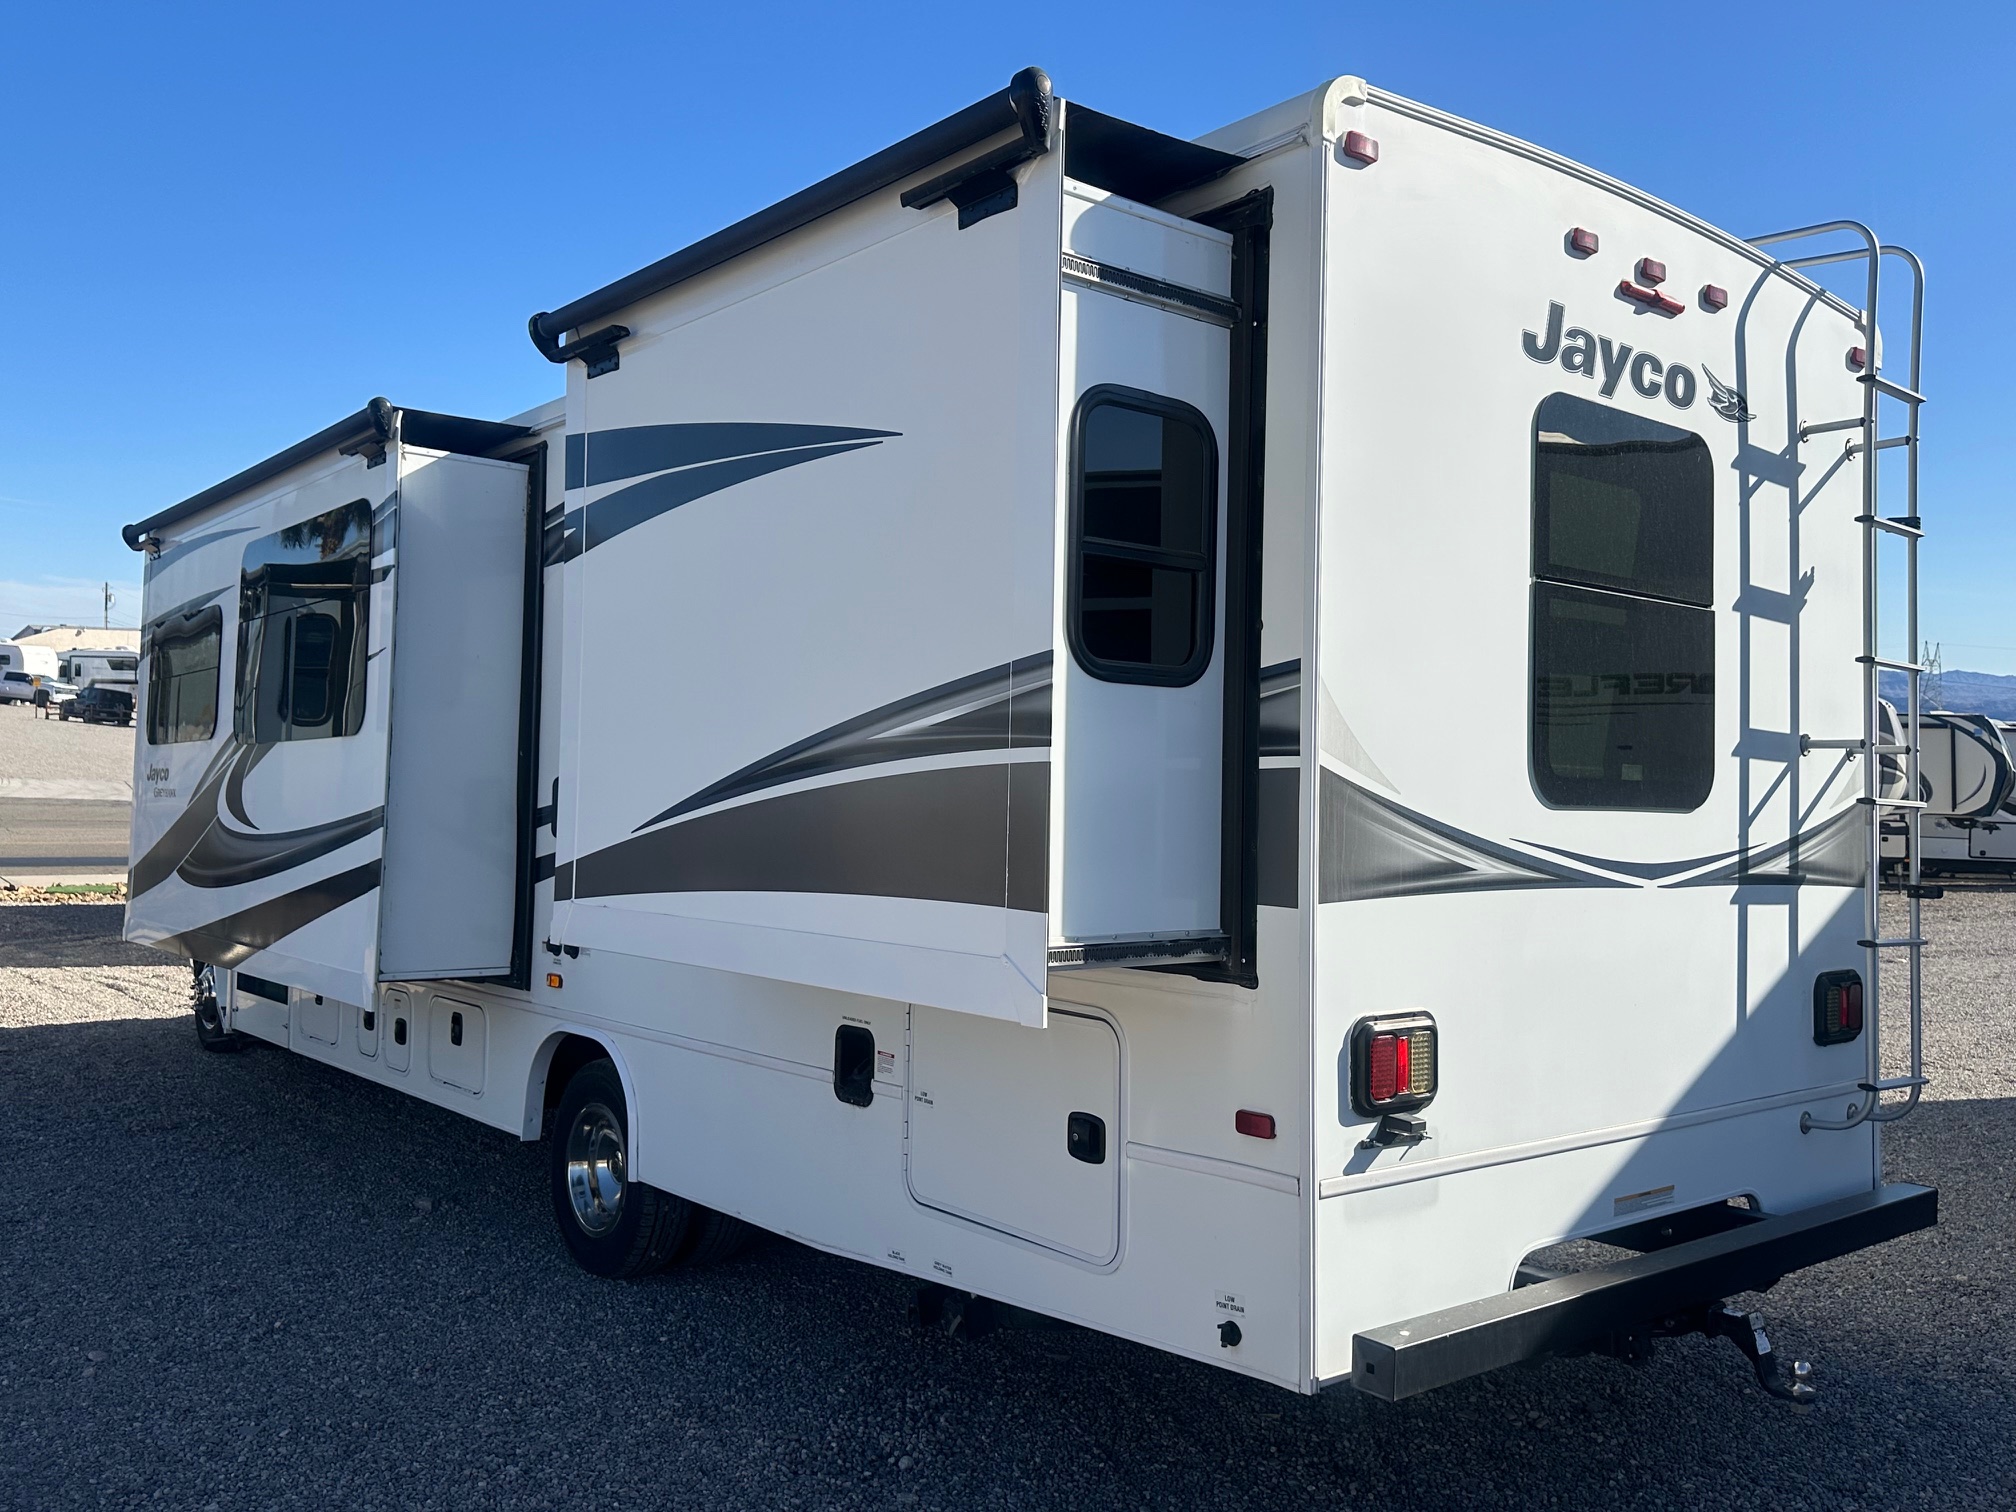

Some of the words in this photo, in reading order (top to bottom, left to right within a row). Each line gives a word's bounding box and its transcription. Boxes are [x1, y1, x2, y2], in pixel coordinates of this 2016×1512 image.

[1521, 299, 1697, 410] Jayco
[147, 763, 169, 785] Jayco
[1216, 1301, 1229, 1310] POINT
[1225, 1295, 1235, 1303] LOW
